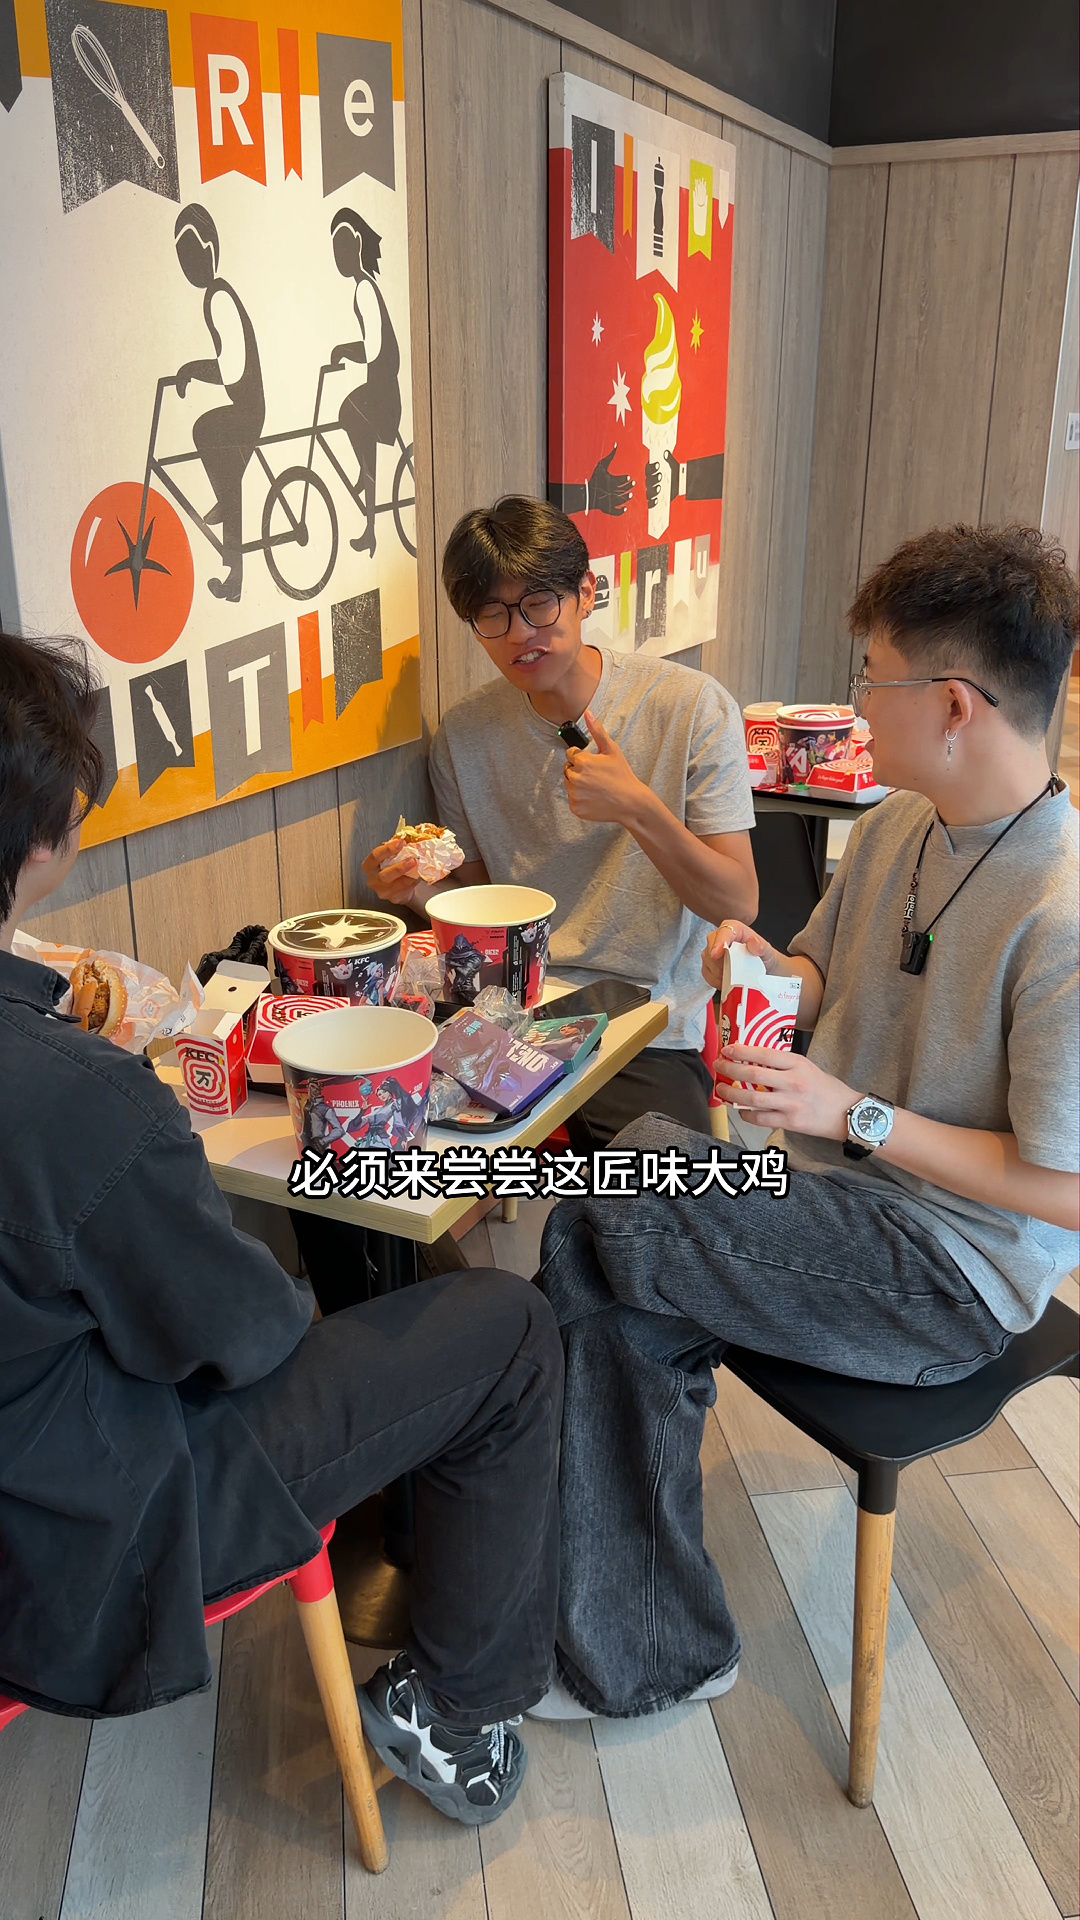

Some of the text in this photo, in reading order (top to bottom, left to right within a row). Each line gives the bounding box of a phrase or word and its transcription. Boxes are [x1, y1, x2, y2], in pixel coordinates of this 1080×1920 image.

[208, 53, 375, 146] R e
[227, 654, 271, 757] T
[354, 956, 370, 965] KFC
[184, 1046, 220, 1065] KFC
[331, 1100, 360, 1108] PHOENIX
